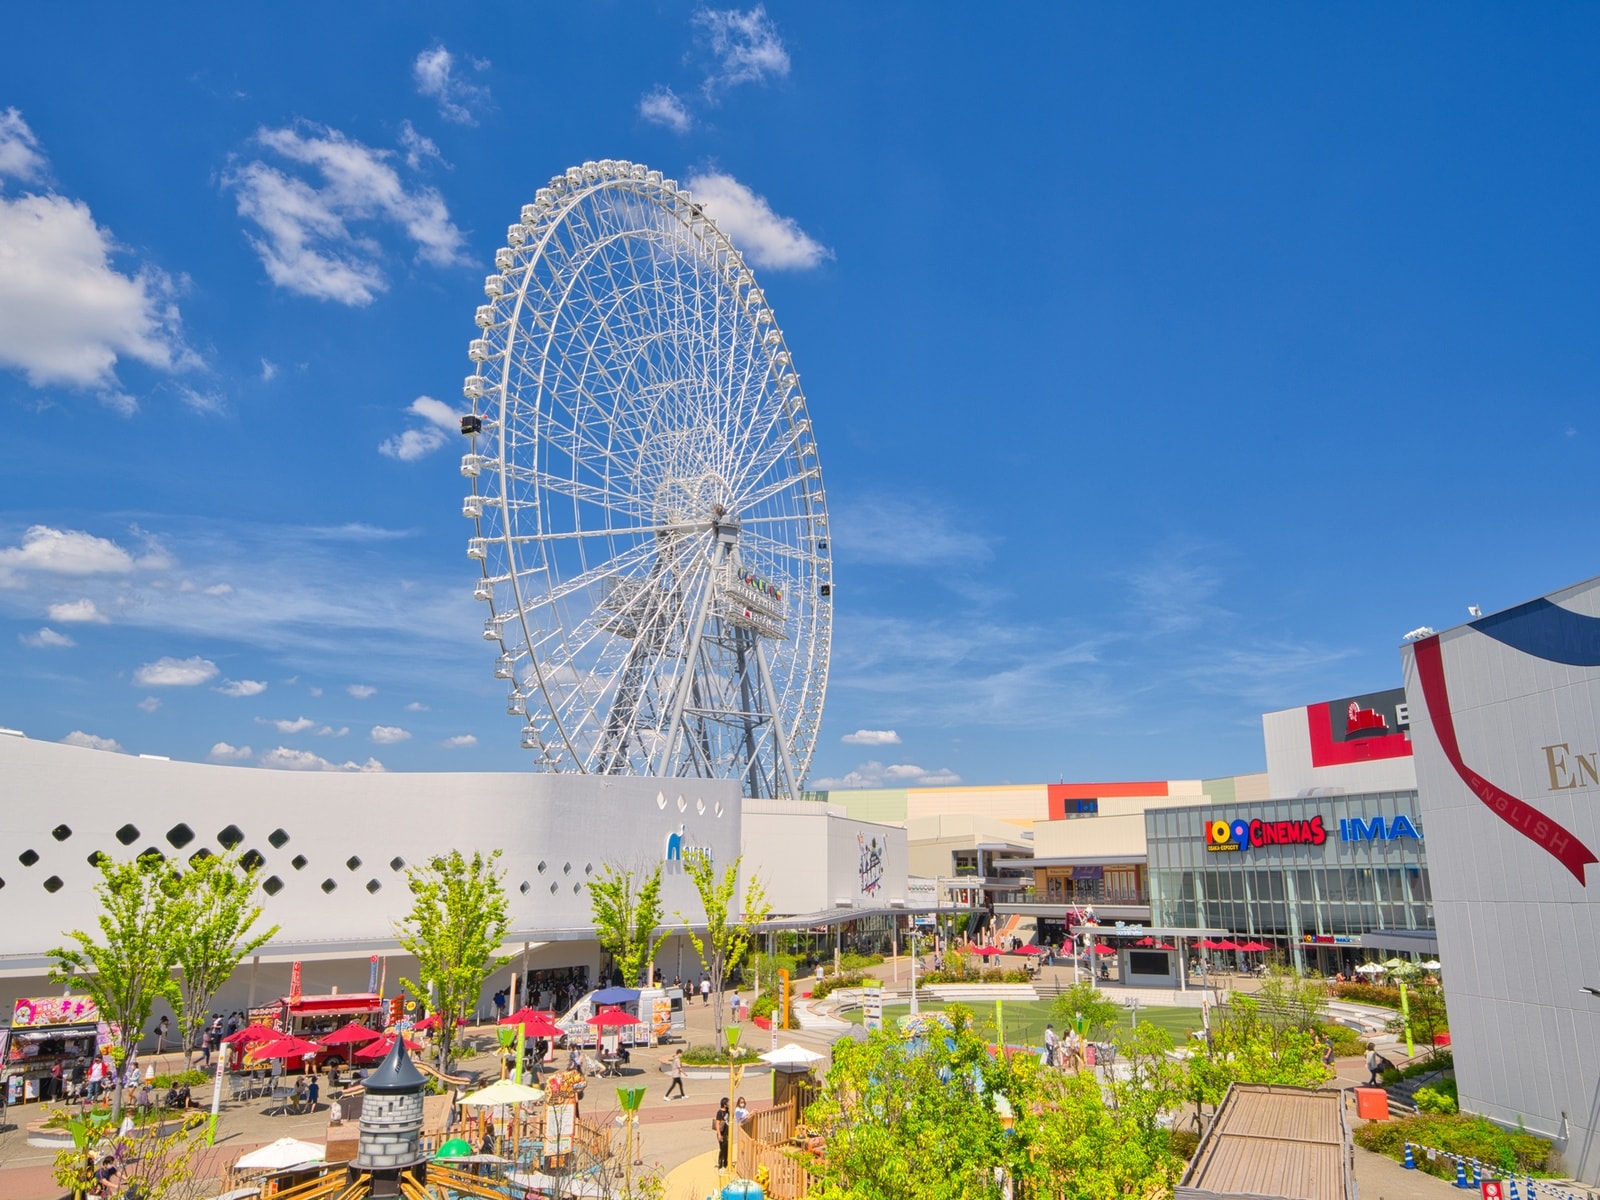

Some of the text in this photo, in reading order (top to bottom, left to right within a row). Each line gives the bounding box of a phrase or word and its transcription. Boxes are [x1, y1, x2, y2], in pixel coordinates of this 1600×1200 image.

[1205, 815, 1326, 851] 109 CINEMAS
[1339, 815, 1424, 841] IMA
[1471, 777, 1569, 855] ENGLISH
